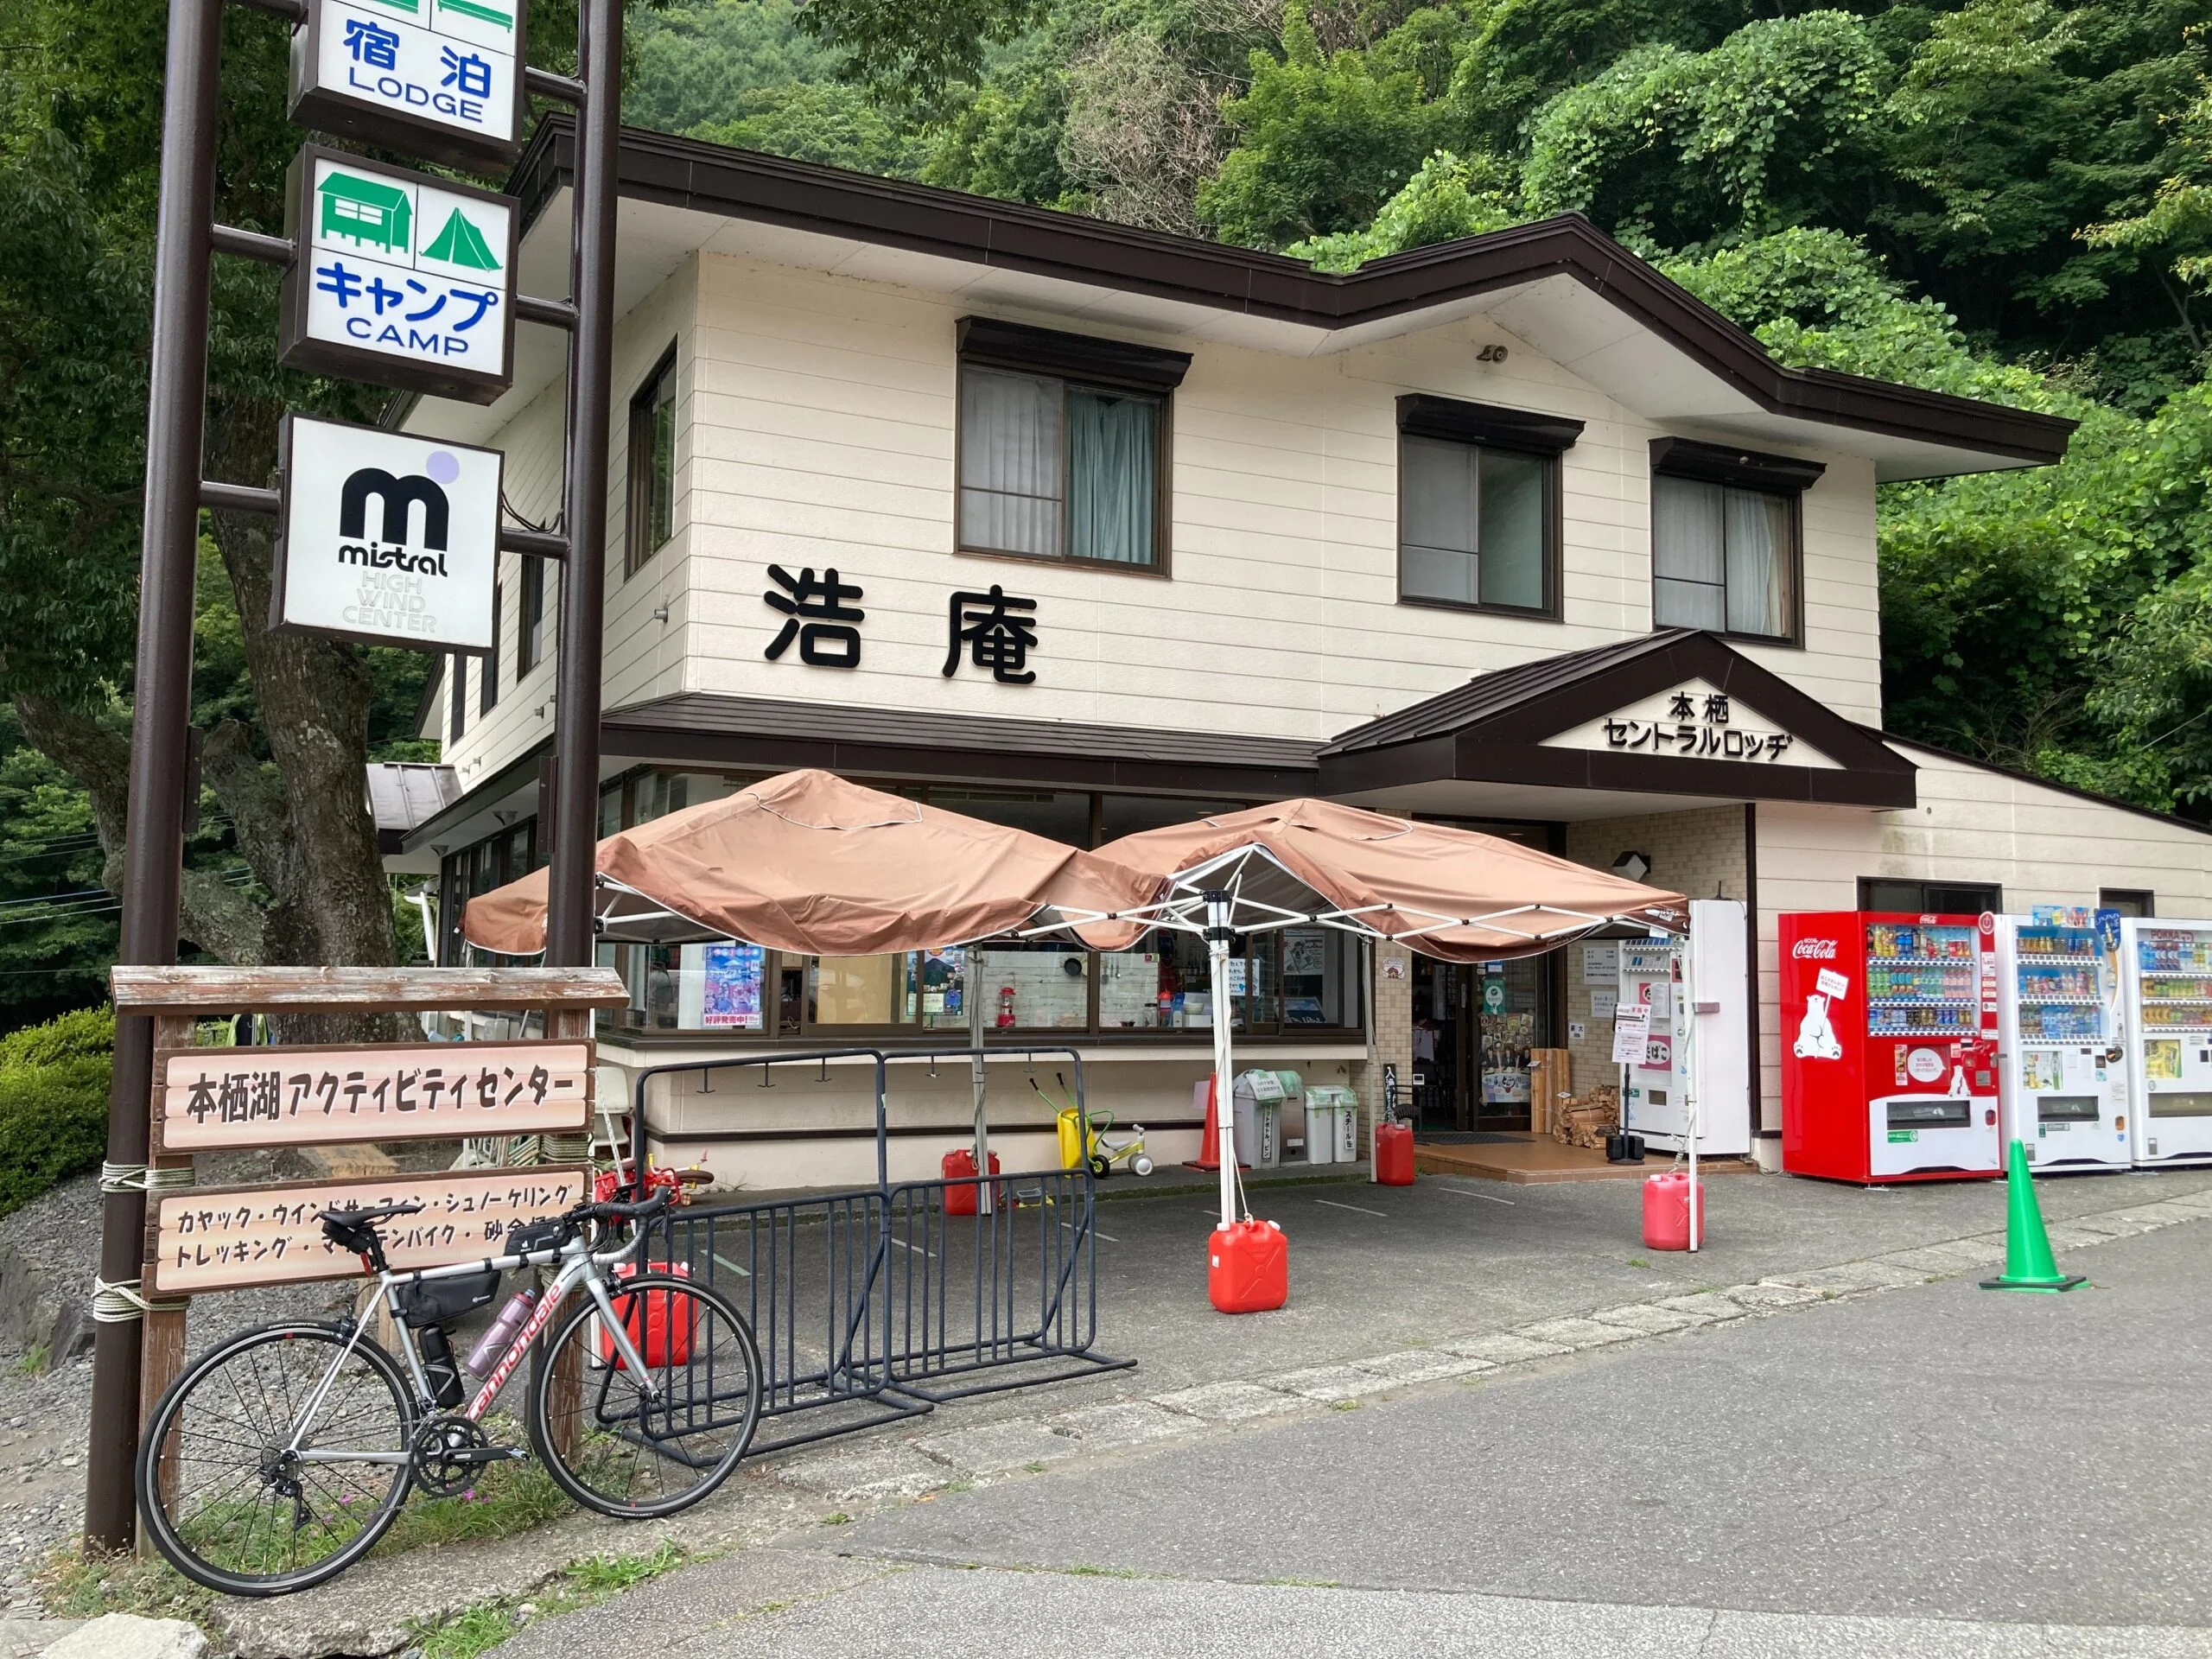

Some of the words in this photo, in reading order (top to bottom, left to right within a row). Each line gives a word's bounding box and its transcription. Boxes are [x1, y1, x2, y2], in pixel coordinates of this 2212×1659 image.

[343, 19, 492, 100] 宿泊
[347, 66, 484, 124] LODGE
[316, 262, 499, 333] キャンプ
[346, 317, 469, 357] CAMP
[338, 543, 448, 578] mistral
[356, 588, 427, 613] WIND
[361, 570, 423, 596] HIGH
[342, 606, 437, 634] CENTER
[764, 563, 1038, 685] 浩庵
[1670, 690, 1729, 724] 本栖
[1603, 717, 1794, 761] セントラルロッヂ
[1792, 939, 1839, 959] Coca-Cola
[705, 1015, 747, 1025] 好評発売中!
[186, 1065, 574, 1125] 本栖湖アクティビティセンター
[1344, 1110, 1353, 1149] スチール缶
[466, 1284, 563, 1421] cannondale
